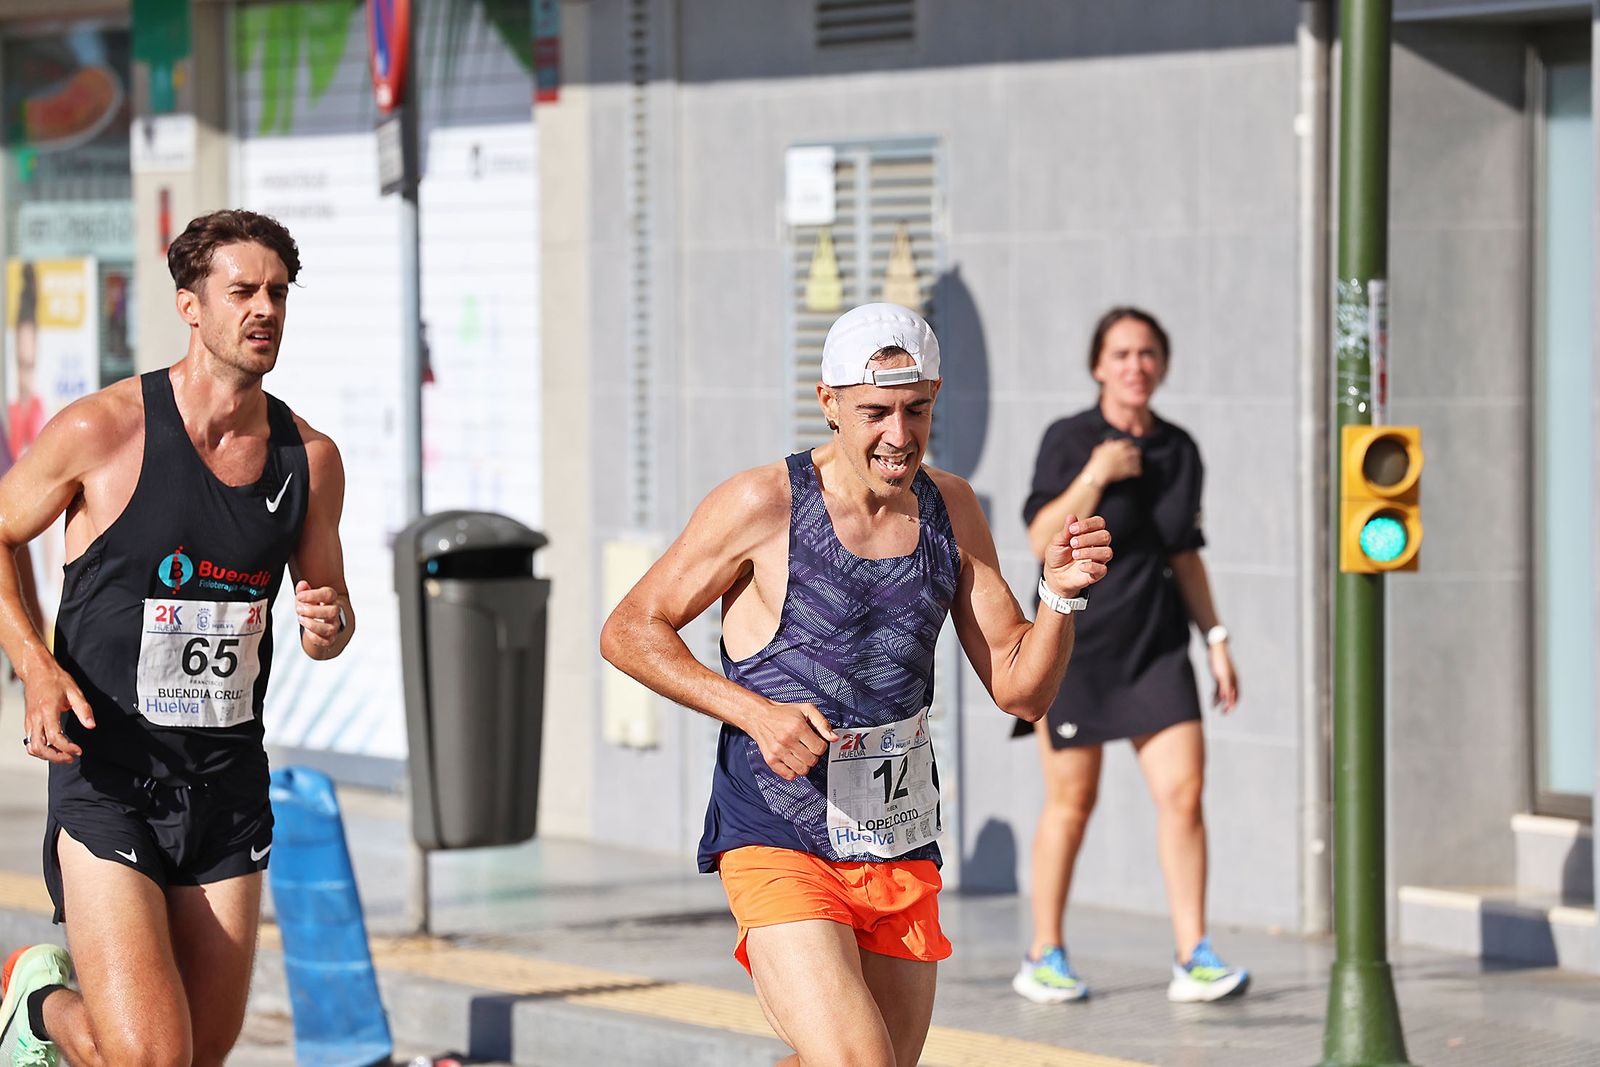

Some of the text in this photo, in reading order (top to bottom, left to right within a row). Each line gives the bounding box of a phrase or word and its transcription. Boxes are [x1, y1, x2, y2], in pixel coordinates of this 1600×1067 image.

[154, 624, 182, 632] HUELVA
[182, 638, 239, 678] 65
[158, 688, 211, 699] BUENDIA
[146, 698, 199, 714] Huelva
[838, 749, 866, 759] HUELVA
[873, 756, 909, 804] 12
[857, 808, 919, 832] LOPEZ COTO
[836, 829, 895, 846] Huelva
